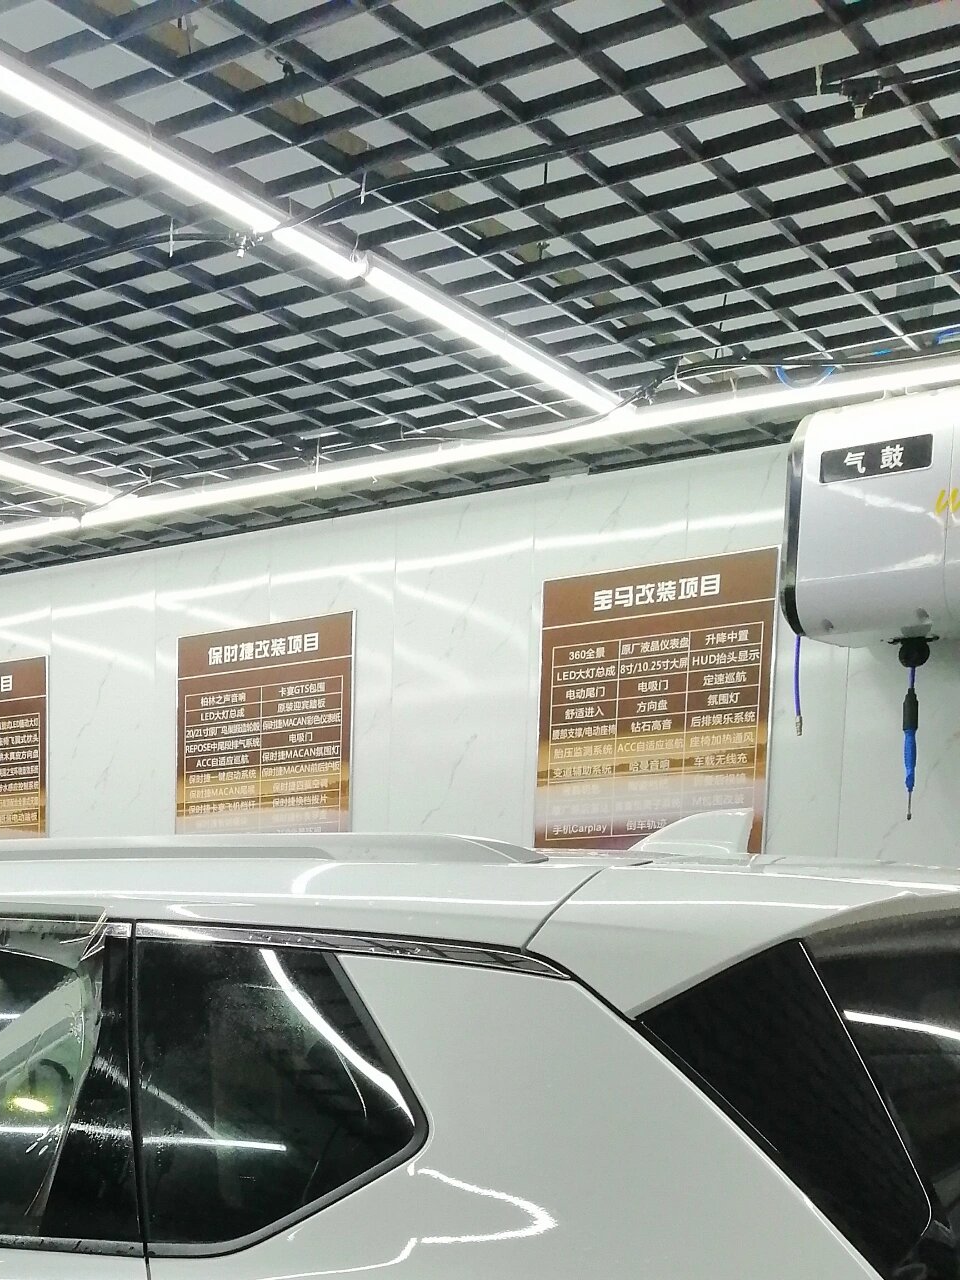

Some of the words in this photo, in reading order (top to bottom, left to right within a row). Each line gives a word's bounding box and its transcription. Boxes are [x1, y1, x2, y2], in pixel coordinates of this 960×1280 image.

[843, 444, 905, 474] 气鼓
[594, 574, 721, 612] 宝马改装项目
[705, 630, 749, 645] 升降中置
[208, 633, 319, 666] 保时捷改装项目
[568, 647, 605, 660] 360全景
[621, 636, 689, 656] 原厂液晶仪表盘
[620, 657, 688, 675] 8寸/10.25寸大屏
[692, 650, 760, 667] HUD抬头显示
[557, 665, 616, 681] LED大灯总成
[703, 671, 746, 687] 定速巡航
[566, 686, 605, 700] 电动尾门
[638, 680, 668, 693] 电吸门
[636, 700, 668, 713] 方向盘
[707, 692, 740, 706] 氛围灯
[201, 708, 245, 721] LED大灯总成
[564, 707, 604, 720] 舒适进入
[690, 711, 755, 728] 后排娱乐系统
[631, 720, 672, 733] 钻石高音
[289, 732, 313, 743] 电吸门
[617, 737, 683, 753] ACC自适应巡航
[690, 730, 753, 748] 座椅加热通风
[554, 743, 612, 759] 胎压监测系统
[552, 822, 607, 835] 手机Carplay
